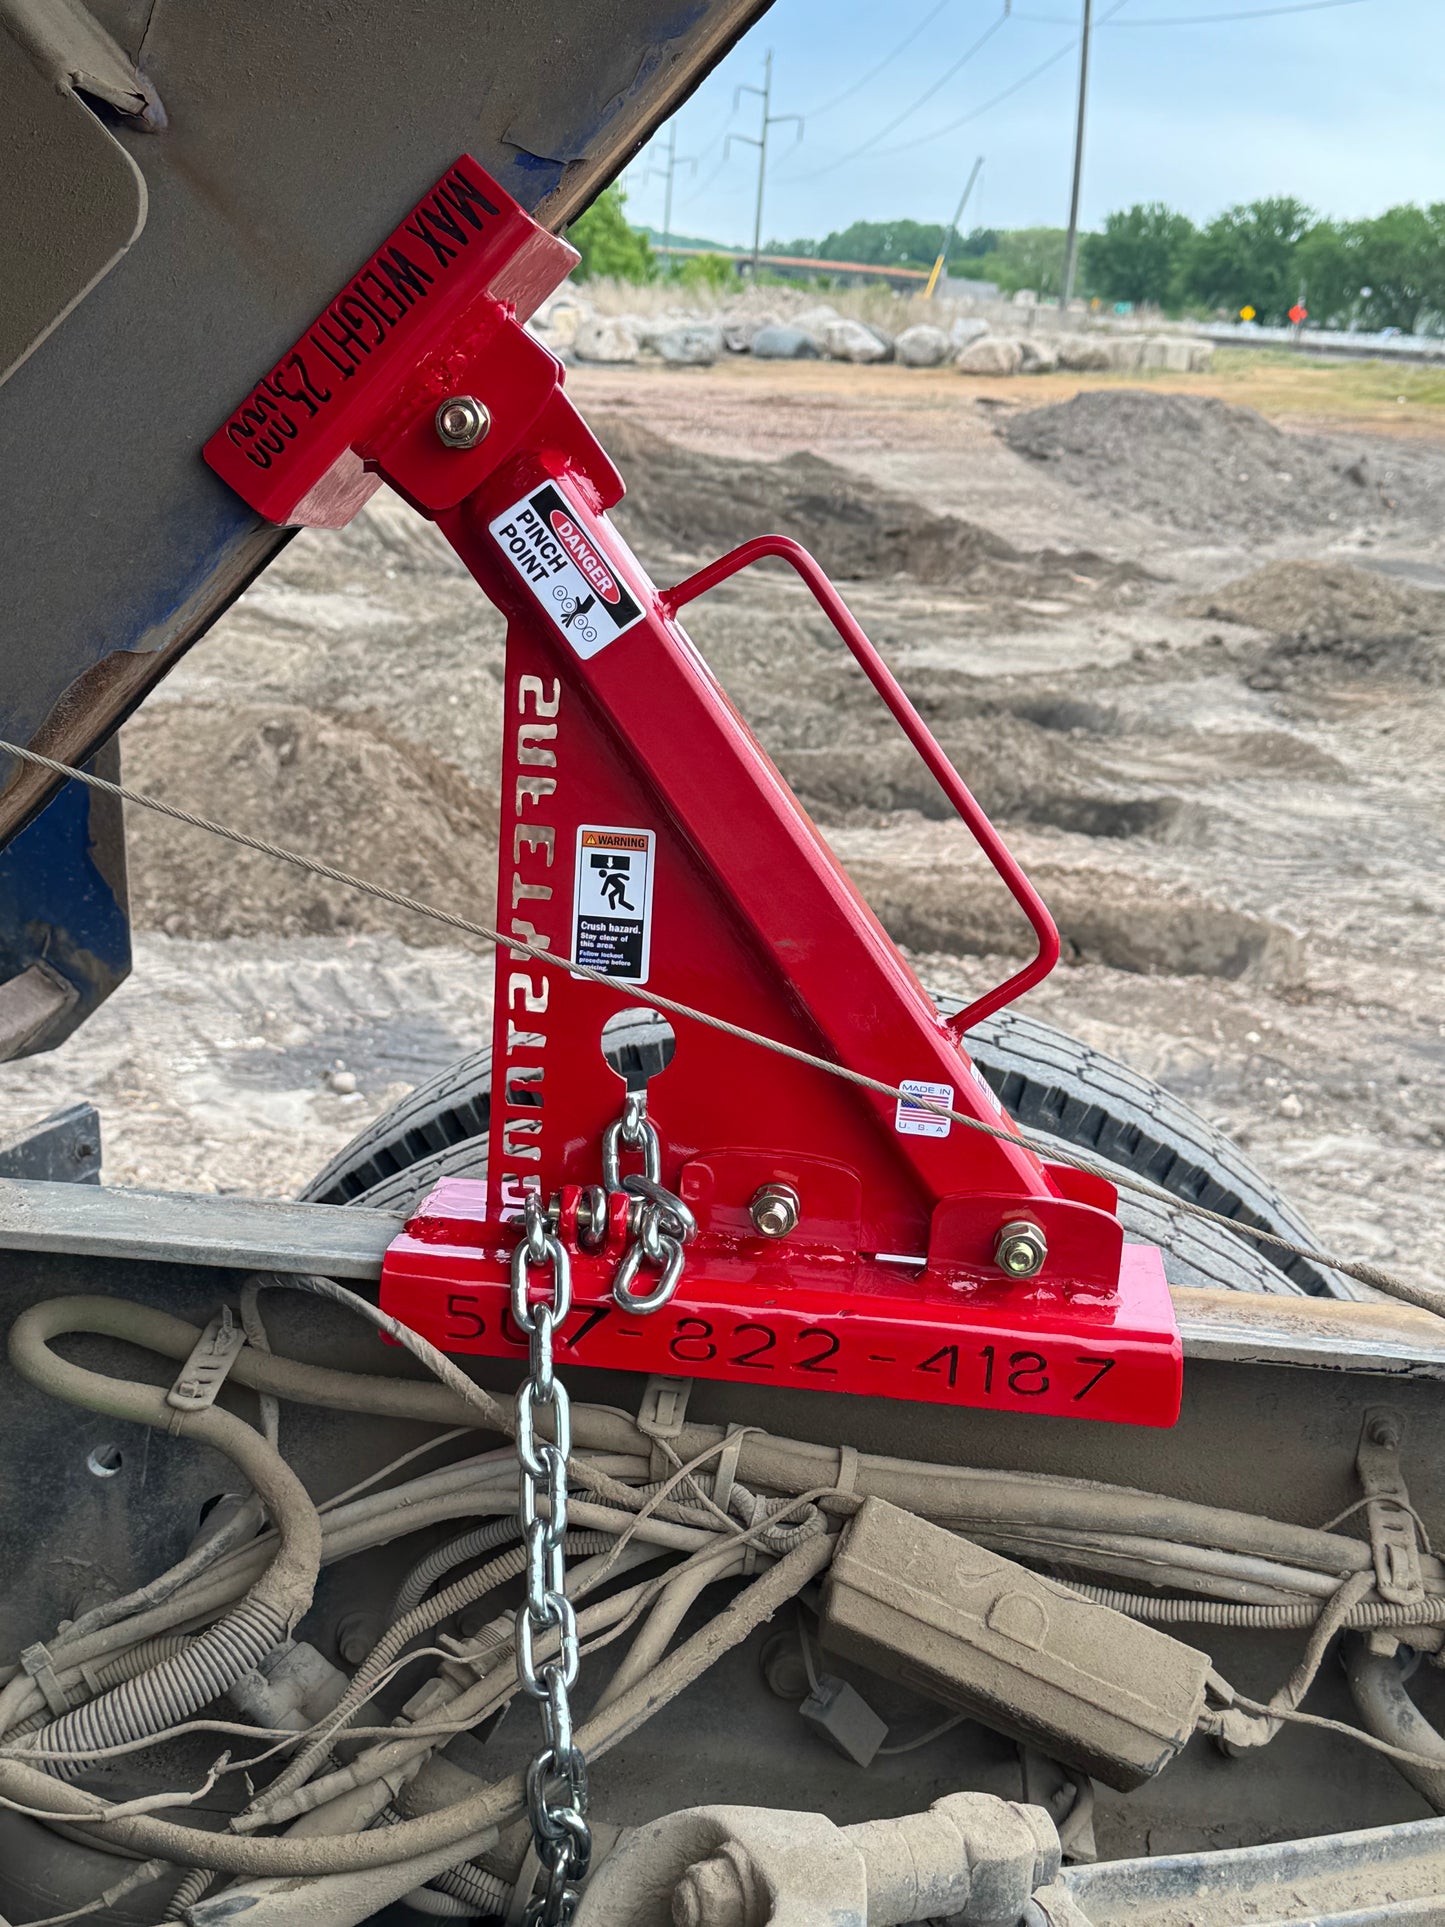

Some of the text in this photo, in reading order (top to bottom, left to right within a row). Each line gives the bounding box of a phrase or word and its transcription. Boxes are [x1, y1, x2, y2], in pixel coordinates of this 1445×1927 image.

[226, 168, 500, 470] MAX WEIGHT 25,000
[515, 508, 568, 574] PINCH
[498, 523, 551, 583] POINT
[556, 520, 613, 594] DANGER
[598, 834, 646, 848] WARNING
[580, 921, 641, 934] Crush hazard.
[580, 932, 597, 941] Stay
[580, 940, 595, 948] this
[579, 957, 610, 965] procedure
[600, 951, 624, 959] lockout
[902, 1084, 951, 1096] MADE IN
